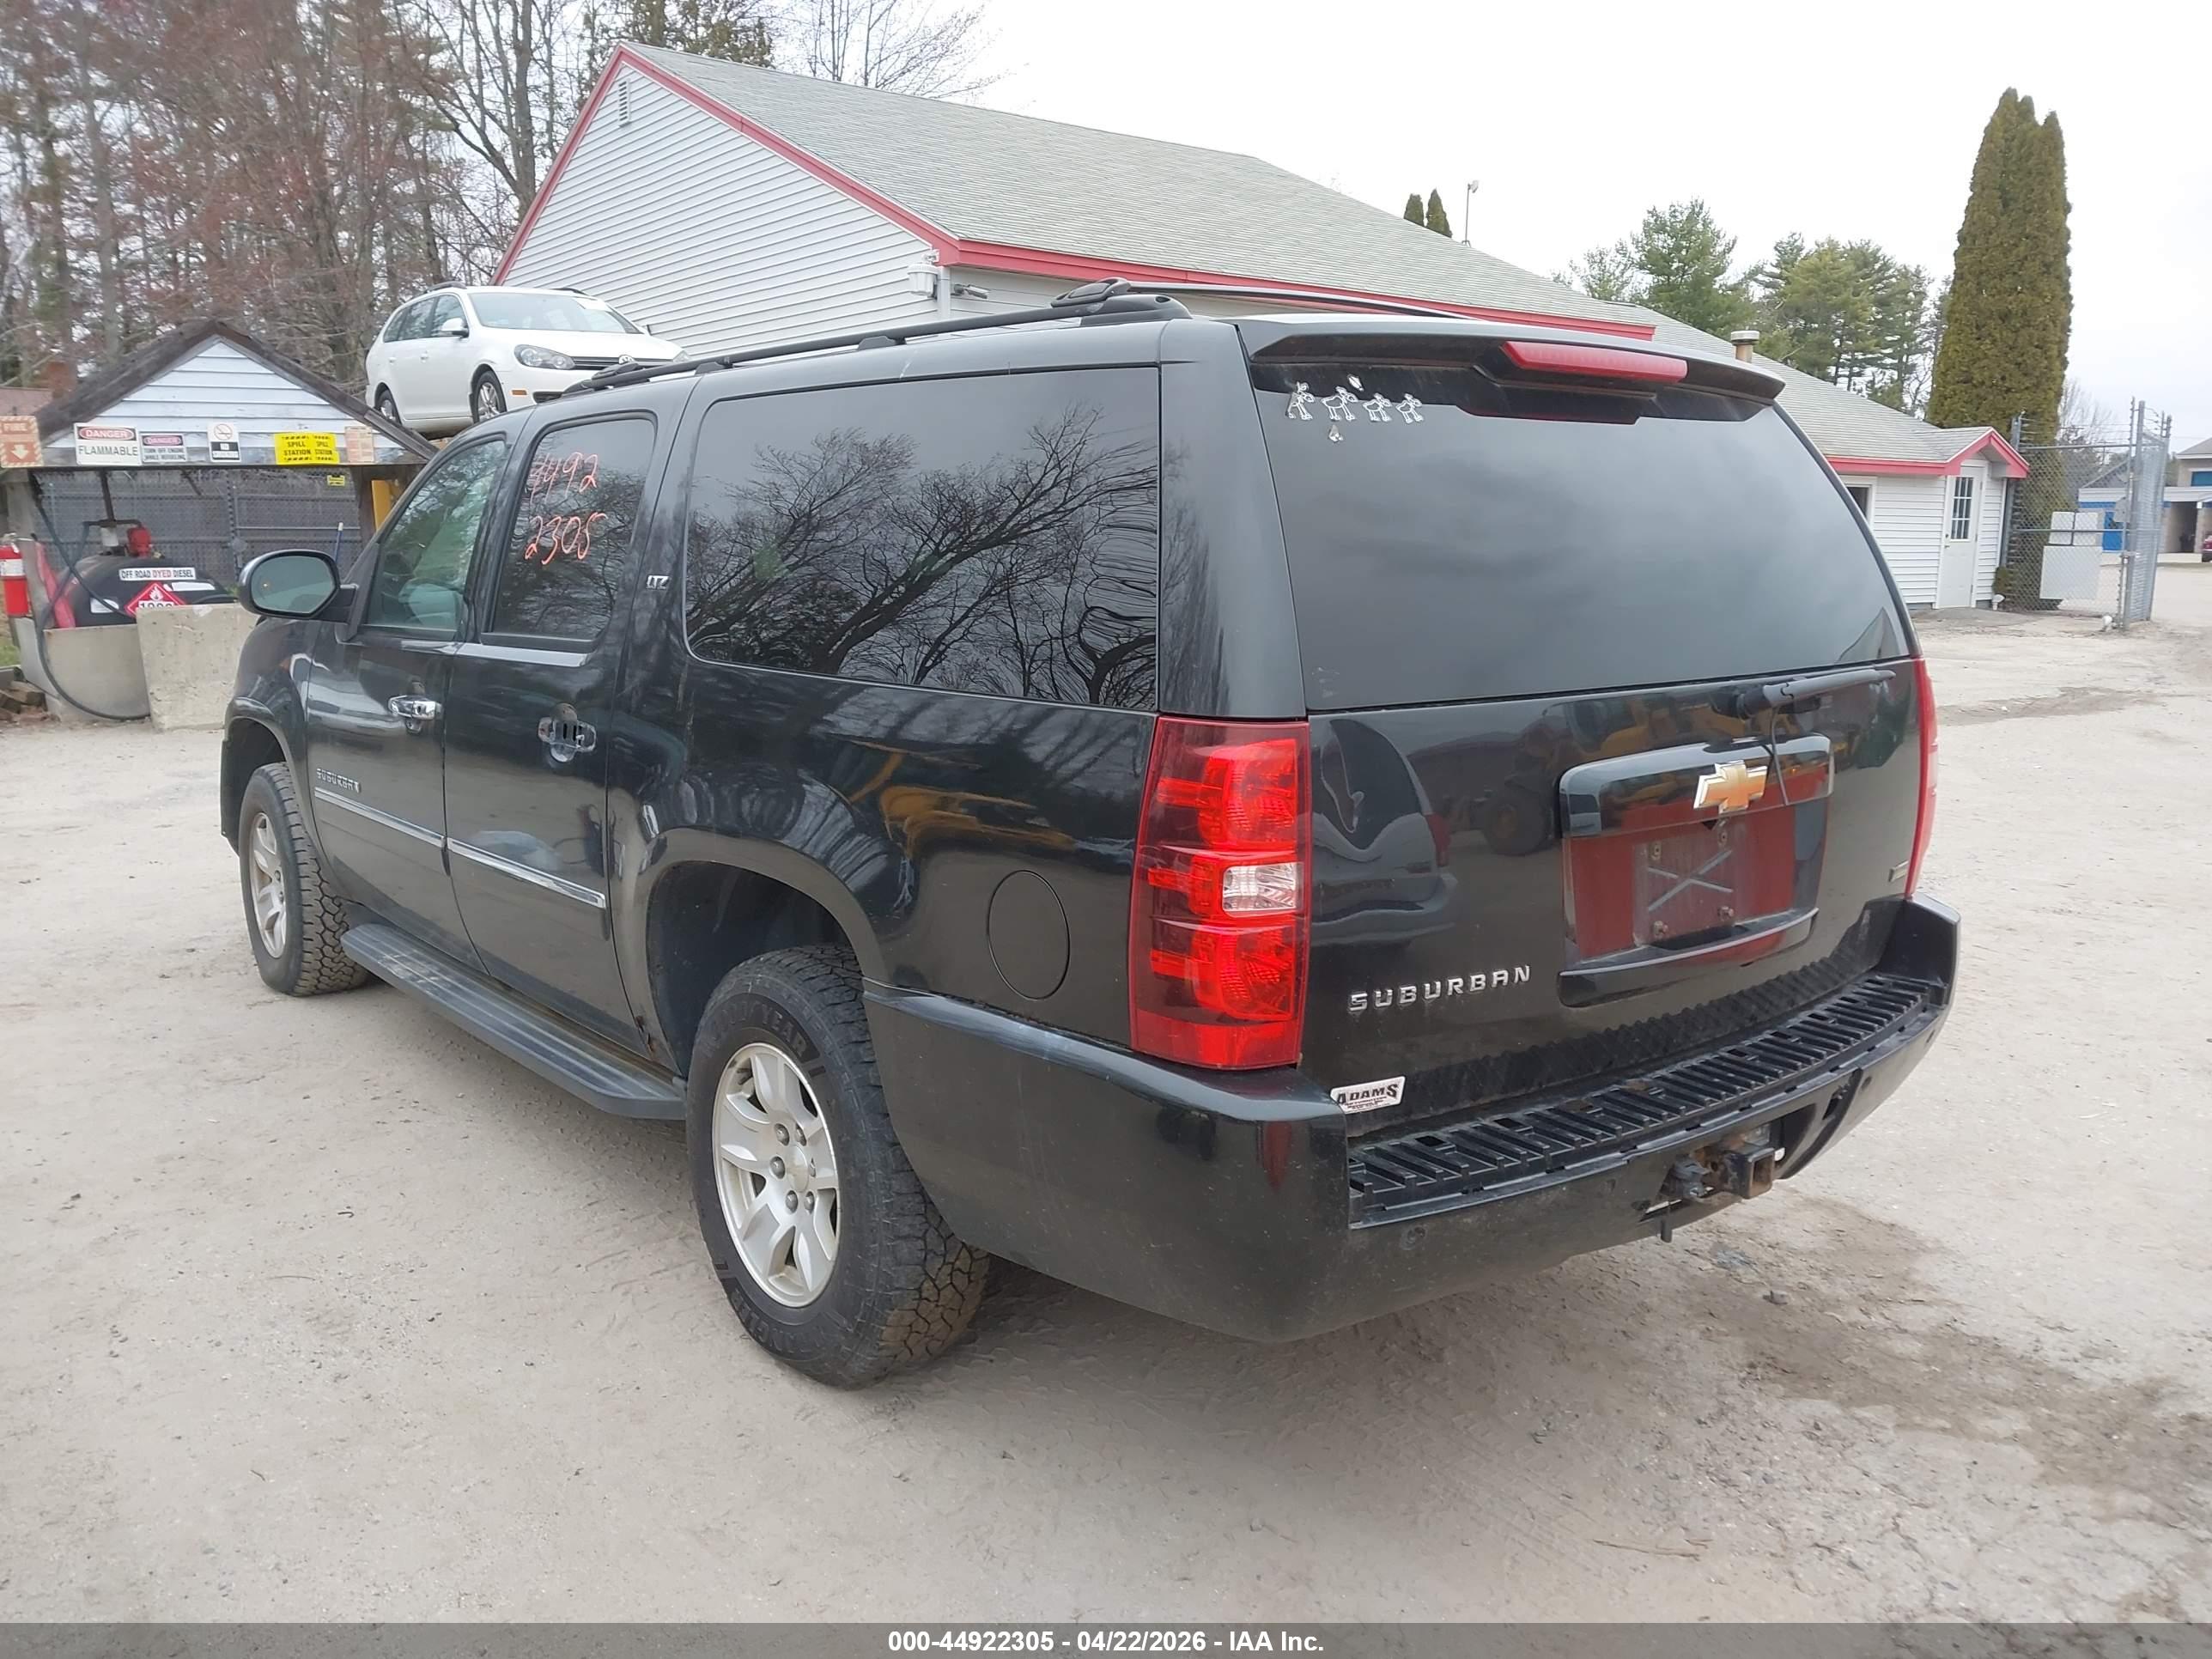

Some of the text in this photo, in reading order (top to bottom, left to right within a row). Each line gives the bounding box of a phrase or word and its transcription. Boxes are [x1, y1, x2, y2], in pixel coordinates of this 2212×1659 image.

[85, 428, 128, 439] DANGER
[147, 436, 179, 445] DANGER
[78, 446, 138, 456] FLAMMABLE
[121, 569, 194, 579] OFF ROAD DYED DIESEL
[646, 574, 669, 590] LTZ
[1349, 965, 1531, 1012] SUBURBAN
[1336, 1083, 1399, 1104] ADAMS
